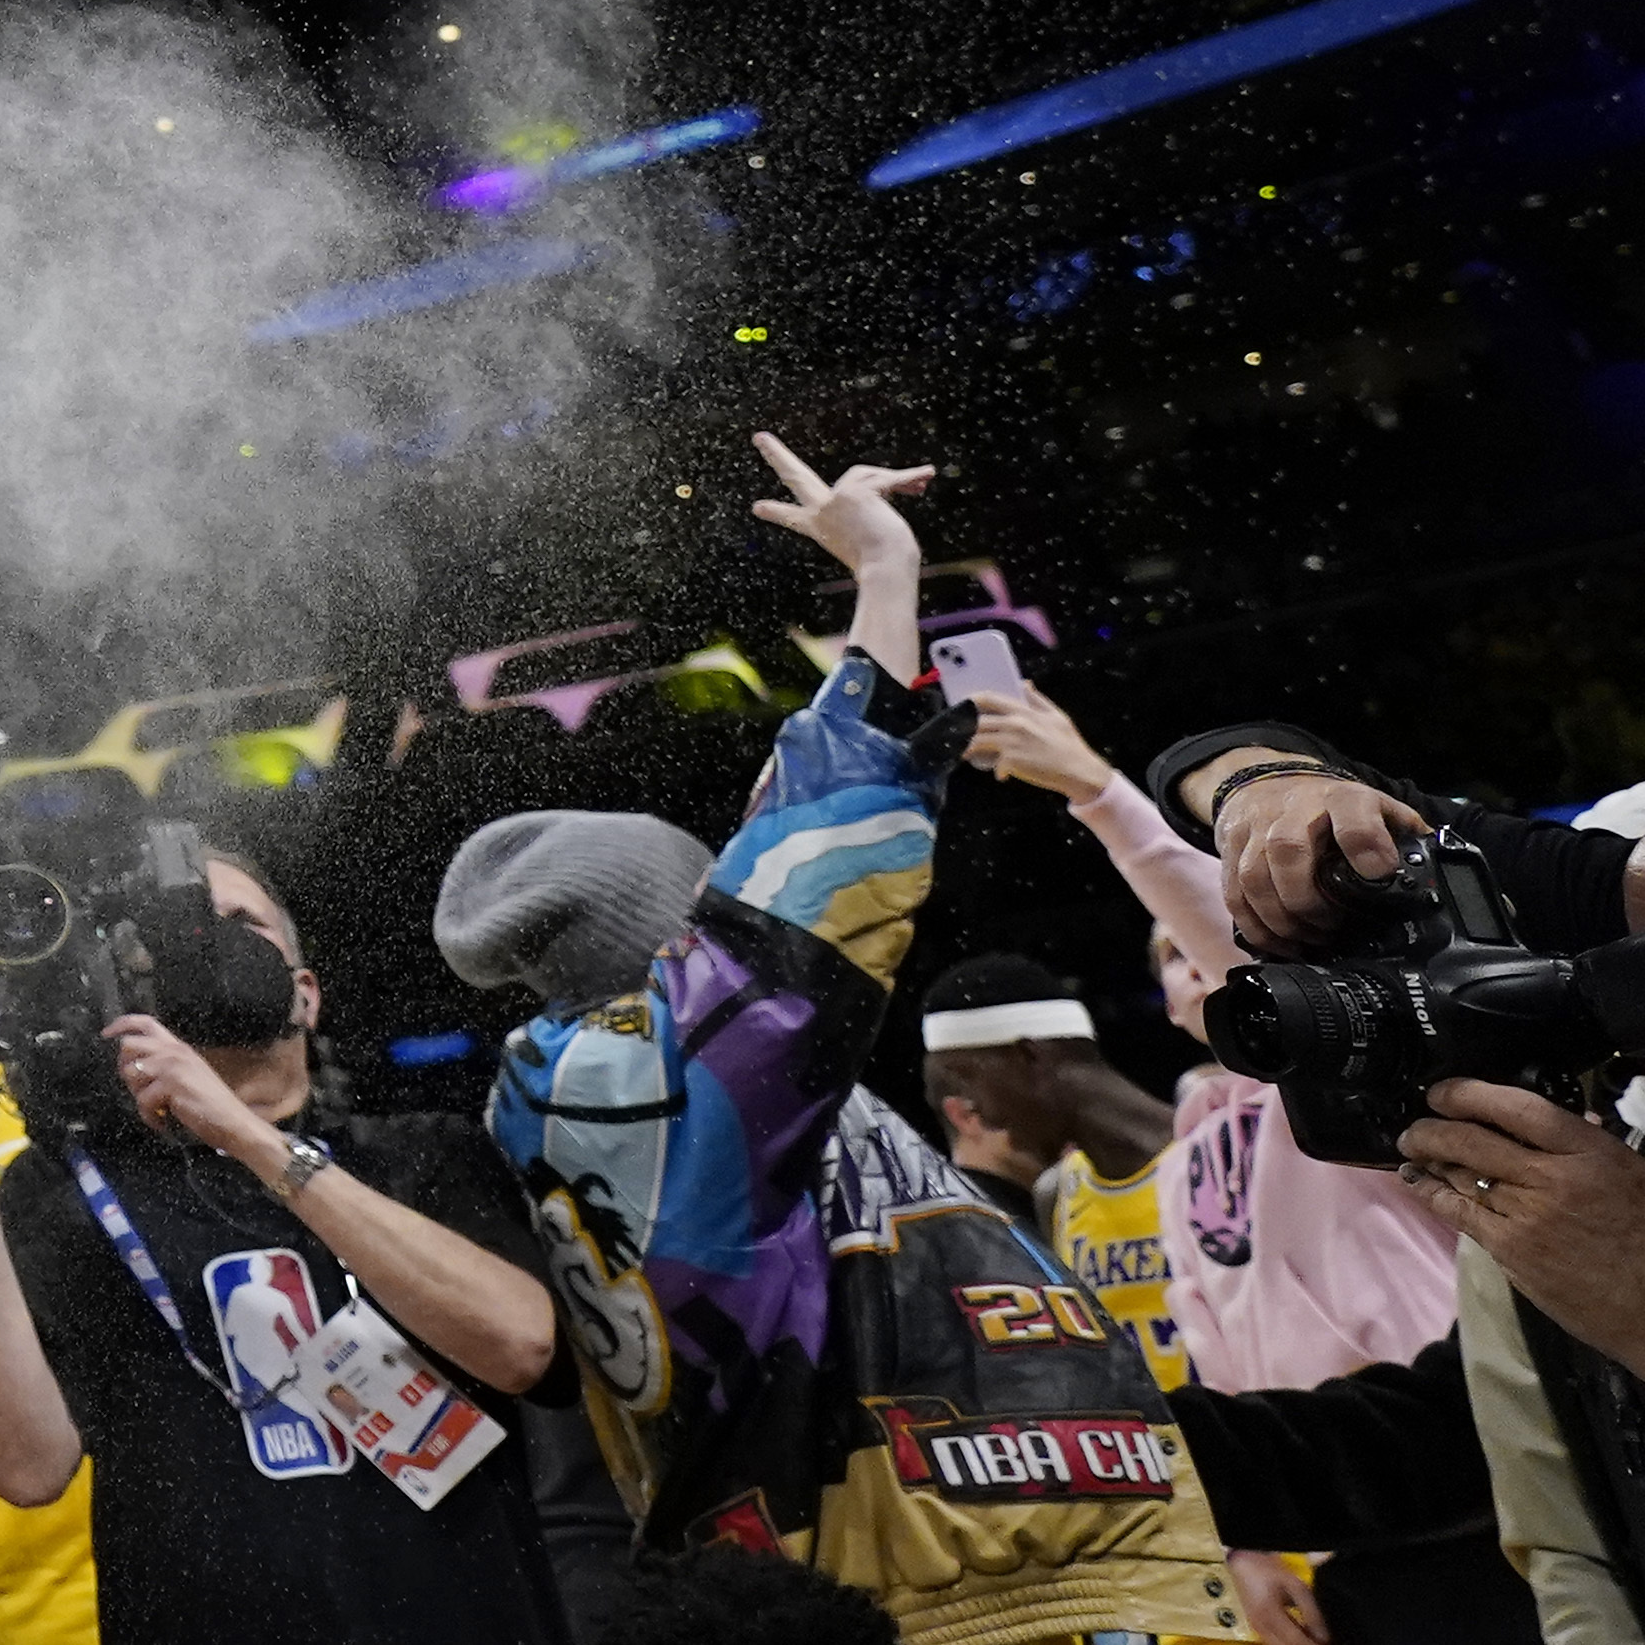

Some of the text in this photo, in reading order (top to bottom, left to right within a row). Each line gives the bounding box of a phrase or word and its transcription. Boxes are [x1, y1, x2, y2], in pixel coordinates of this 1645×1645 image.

[1404, 972, 1437, 1036] Nikon
[959, 1283, 1107, 1346] 20
[264, 1423, 316, 1464] NBA
[931, 1431, 1072, 1486] NBA
